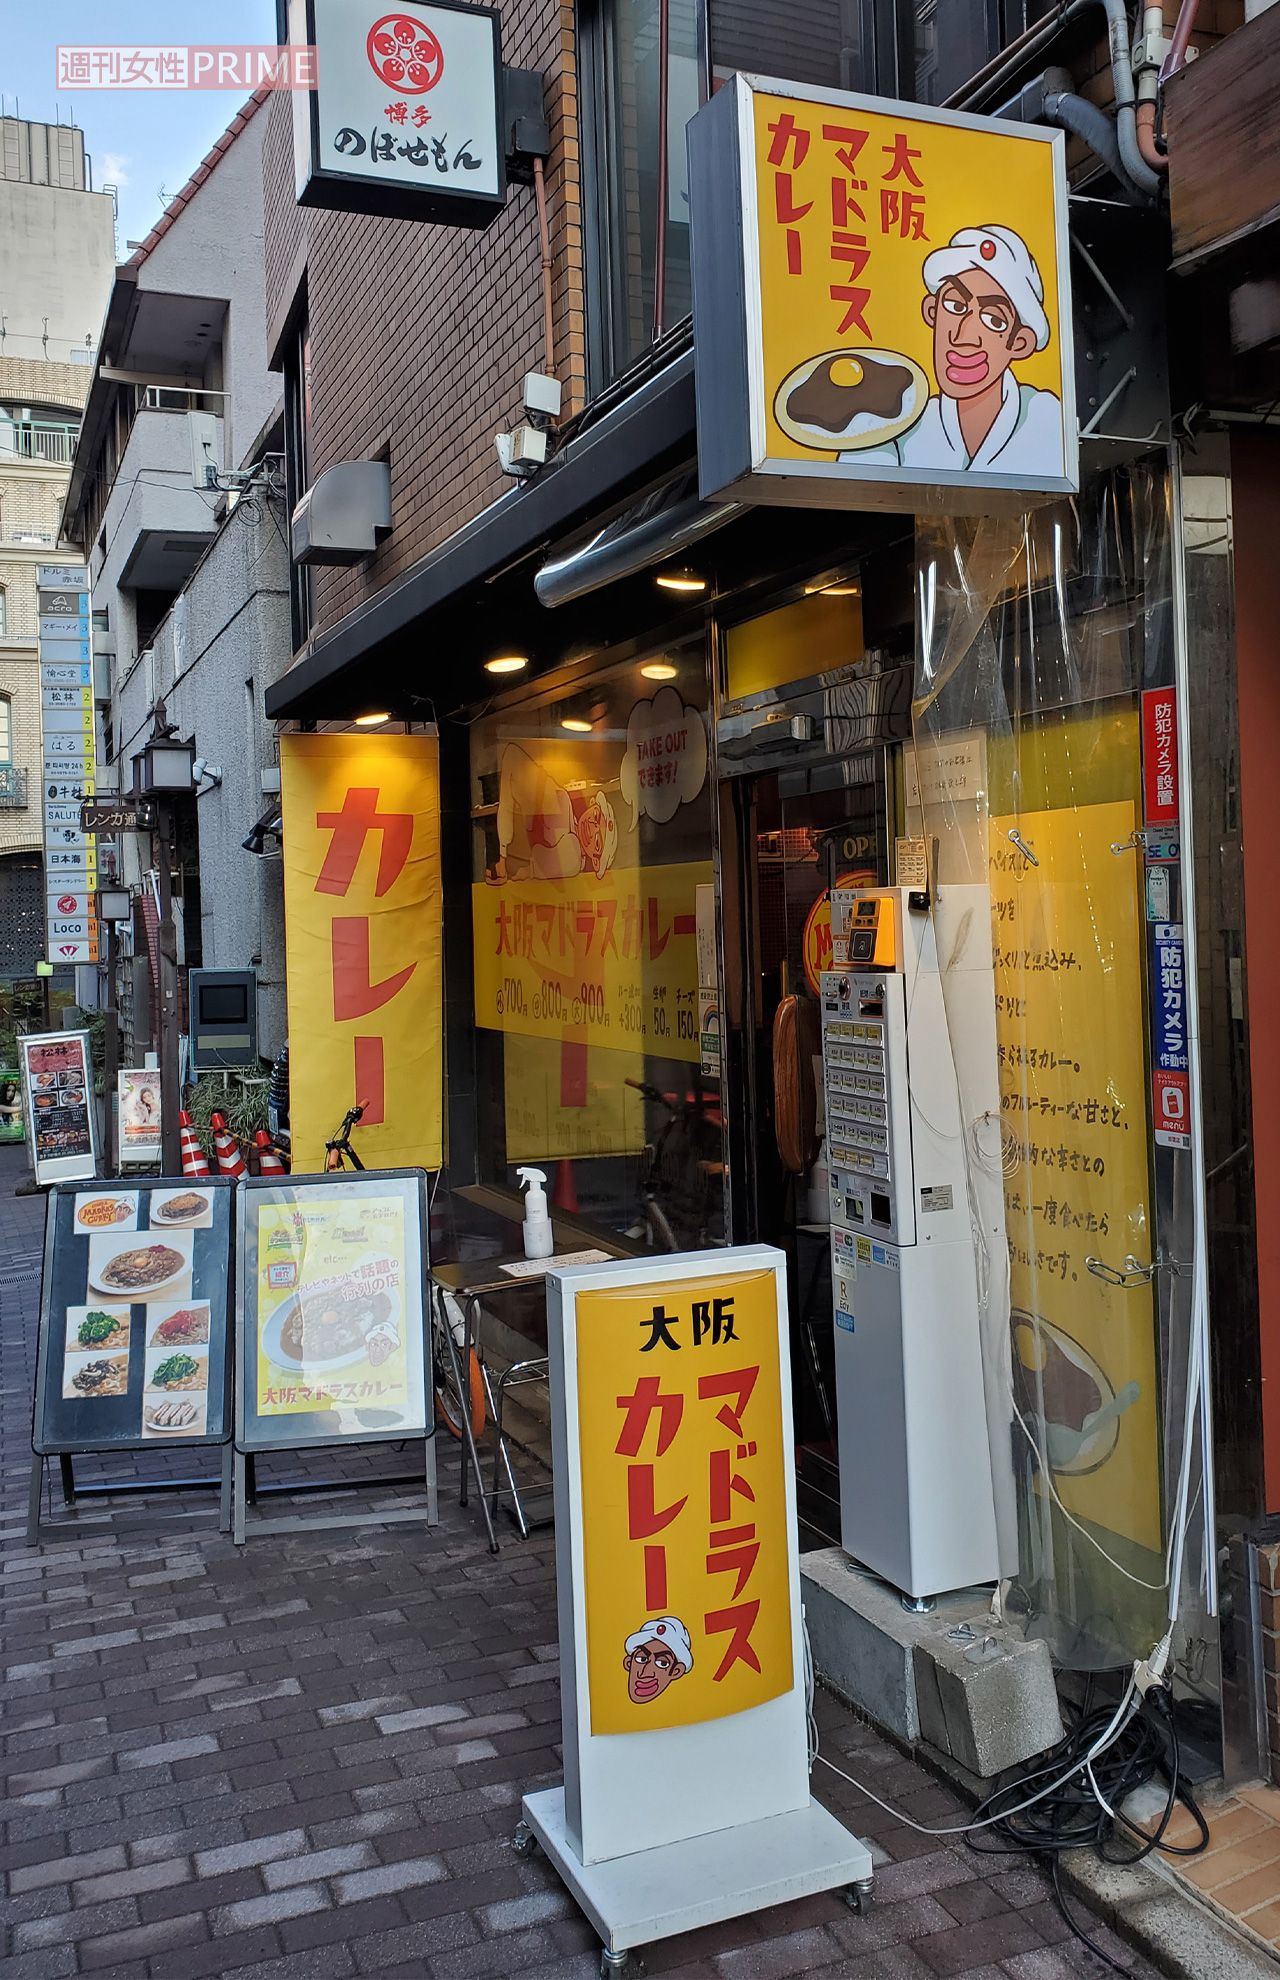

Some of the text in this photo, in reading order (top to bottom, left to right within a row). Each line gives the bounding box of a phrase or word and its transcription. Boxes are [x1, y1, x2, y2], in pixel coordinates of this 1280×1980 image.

[384, 102, 432, 128] 博多
[334, 126, 483, 173] のぼせもん
[767, 113, 814, 275] カレー
[881, 133, 931, 242] 大阪
[822, 124, 874, 341] マドラス
[62, 576, 84, 584] 赤坂
[82, 624, 88, 632] 3
[82, 646, 88, 656] 3
[83, 669, 89, 678] 3
[51, 692, 90, 701] 松林 2
[85, 716, 90, 724] 2
[85, 739, 91, 747] 2
[636, 729, 688, 761] TAKE OUT
[1155, 703, 1175, 806] 防犯カメラ設置
[86, 763, 92, 771] 2
[51, 855, 81, 864] 日本海
[54, 922, 82, 933] Loco
[495, 894, 697, 961] 大阪マドラスカレー
[314, 787, 418, 1127] カレー
[676, 988, 696, 1006] チーズ
[1160, 946, 1183, 1052] 防犯カメラ
[40, 1047, 69, 1058] 松林
[1160, 1053, 1188, 1069] 作動中
[1162, 1120, 1184, 1131] menu
[341, 1273, 400, 1301] 行列の店
[638, 1297, 741, 1352] 大阪
[261, 1380, 404, 1406] 大阪マドラスカレー
[614, 1376, 689, 1612] カレー
[697, 1365, 762, 1683] マドラス
